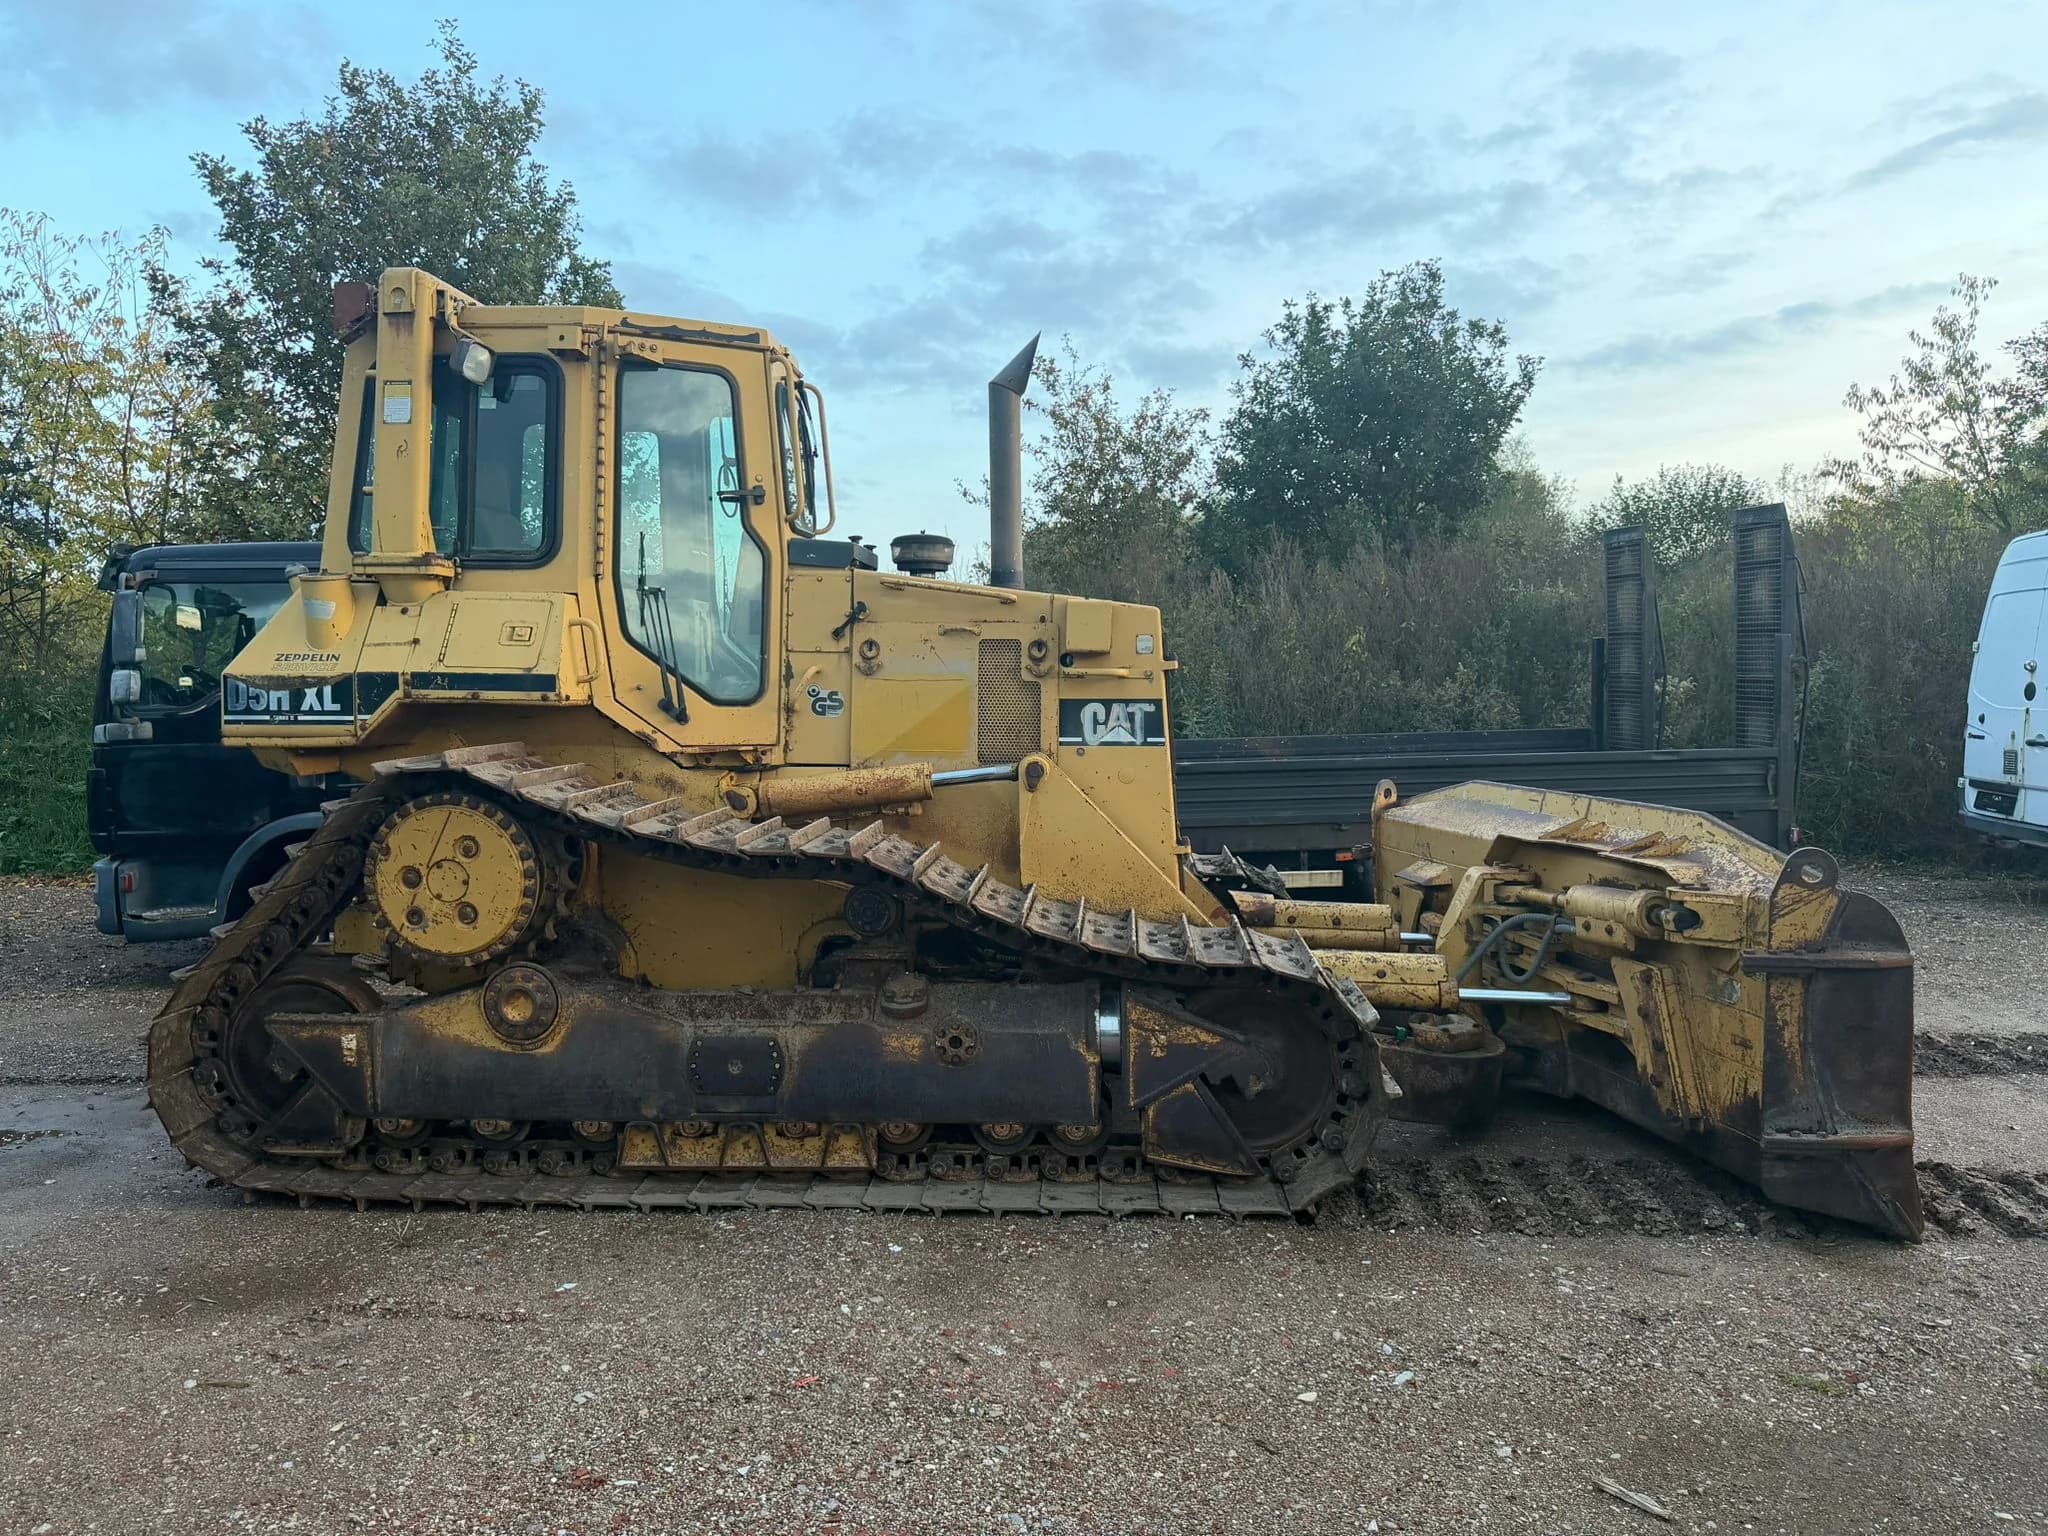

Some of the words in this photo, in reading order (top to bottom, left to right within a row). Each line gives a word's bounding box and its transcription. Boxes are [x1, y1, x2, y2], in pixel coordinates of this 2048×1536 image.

[270, 662, 338, 672] SERVICE
[274, 653, 341, 662] ZEPPELIN
[300, 685, 341, 711] XL
[811, 690, 844, 716] GS
[1080, 702, 1156, 746] CAT
